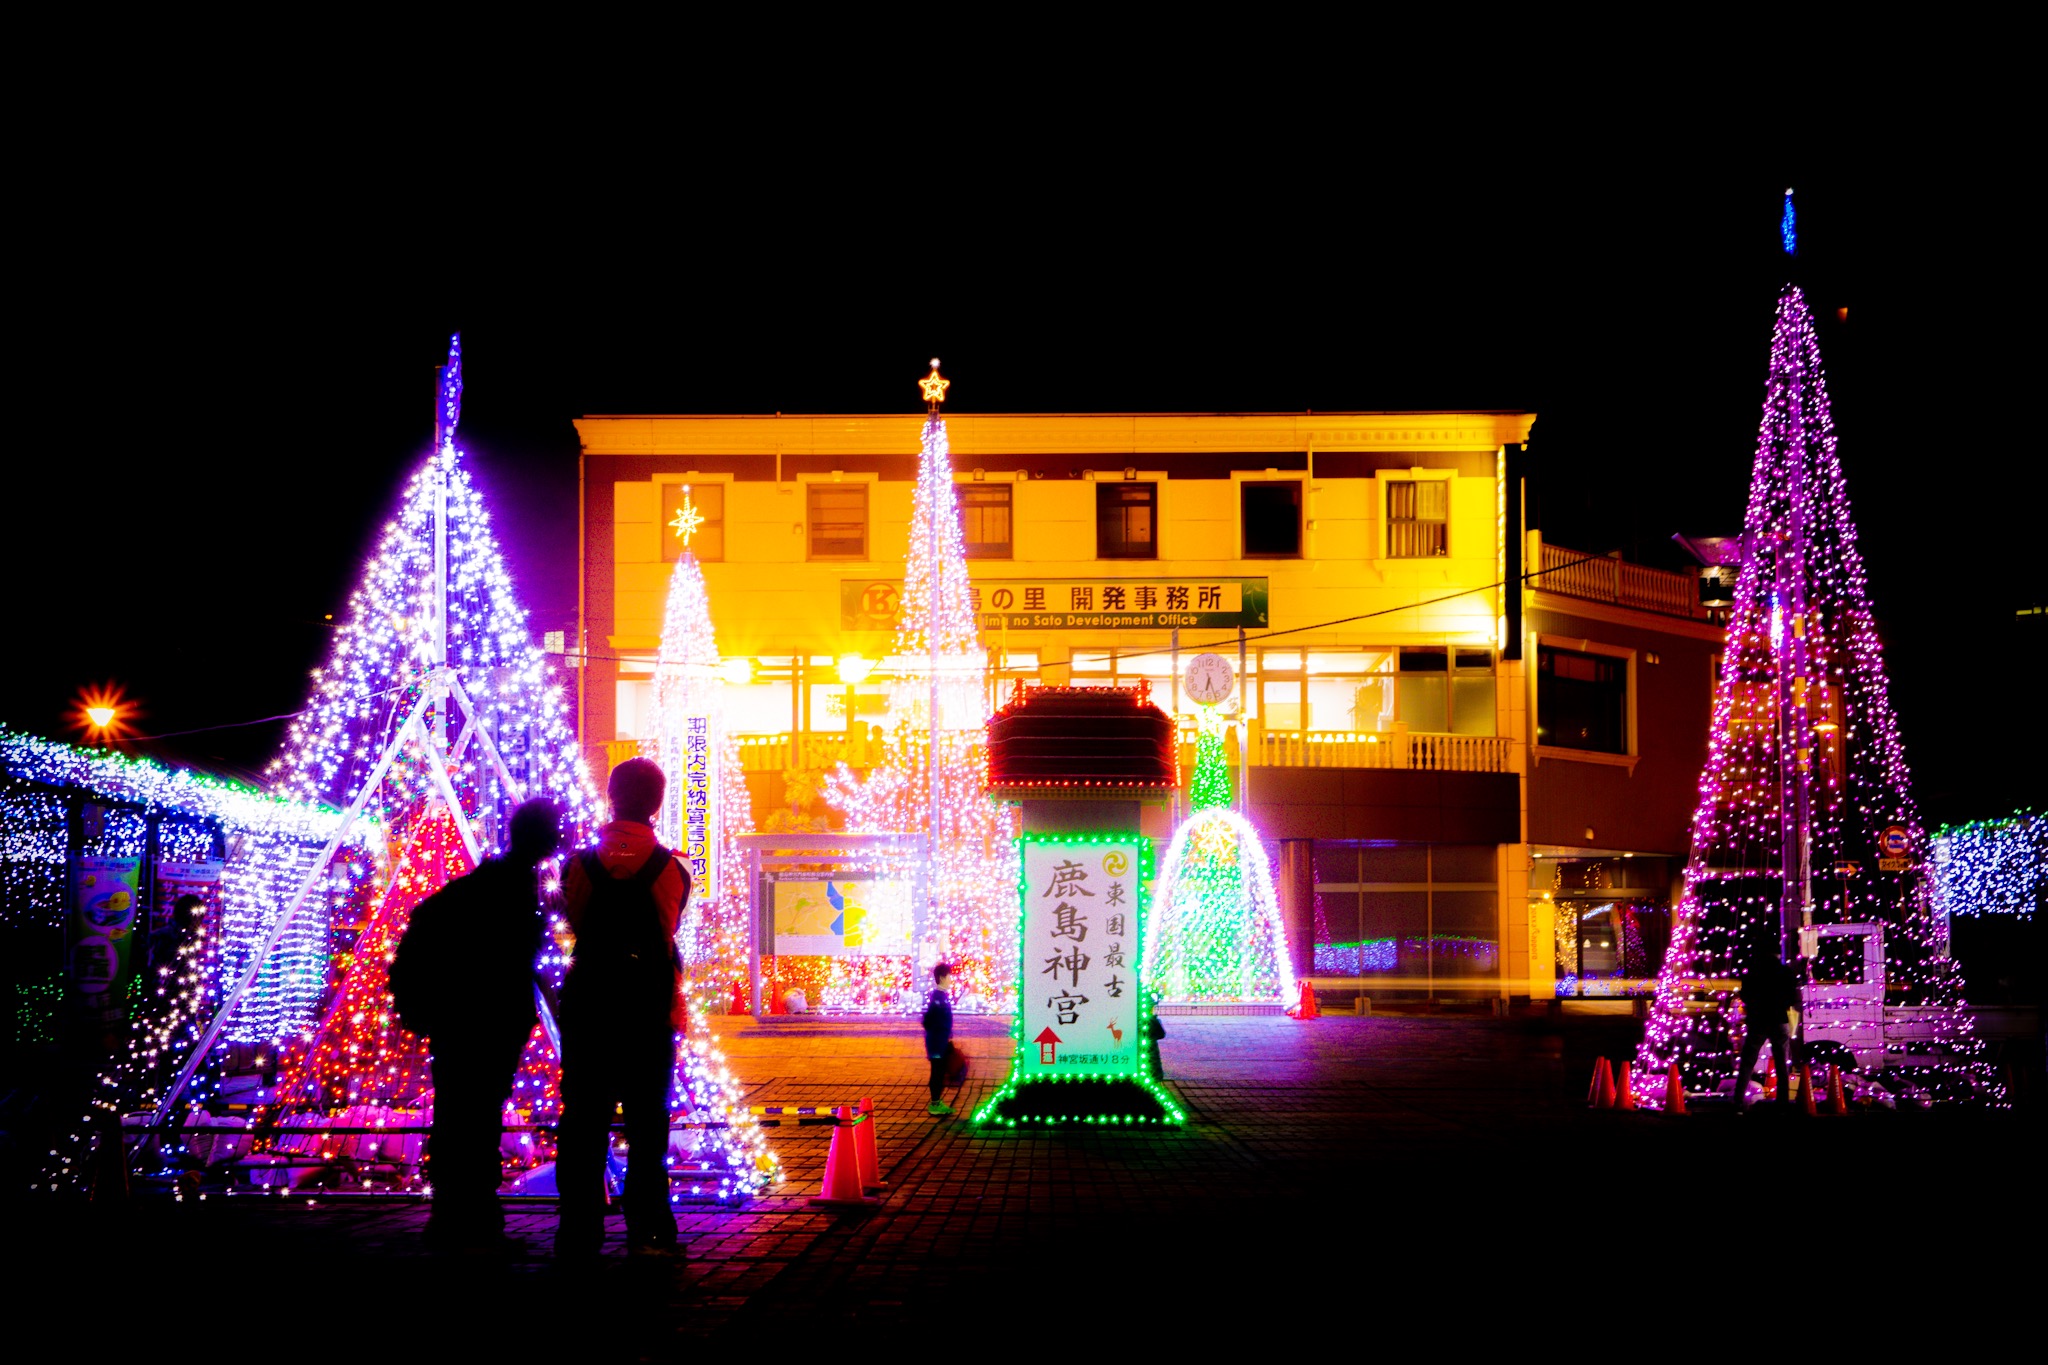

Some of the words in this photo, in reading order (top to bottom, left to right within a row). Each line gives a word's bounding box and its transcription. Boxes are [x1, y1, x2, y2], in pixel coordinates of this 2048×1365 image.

[1013, 616, 1030, 626] no
[1034, 615, 1062, 626] Sato
[1066, 614, 1153, 628] Development
[1158, 614, 1198, 626] Office
[1071, 586, 1221, 611] 開発事務所
[1042, 859, 1096, 1026] 鹿島神宮
[1103, 882, 1126, 998] 東国最古
